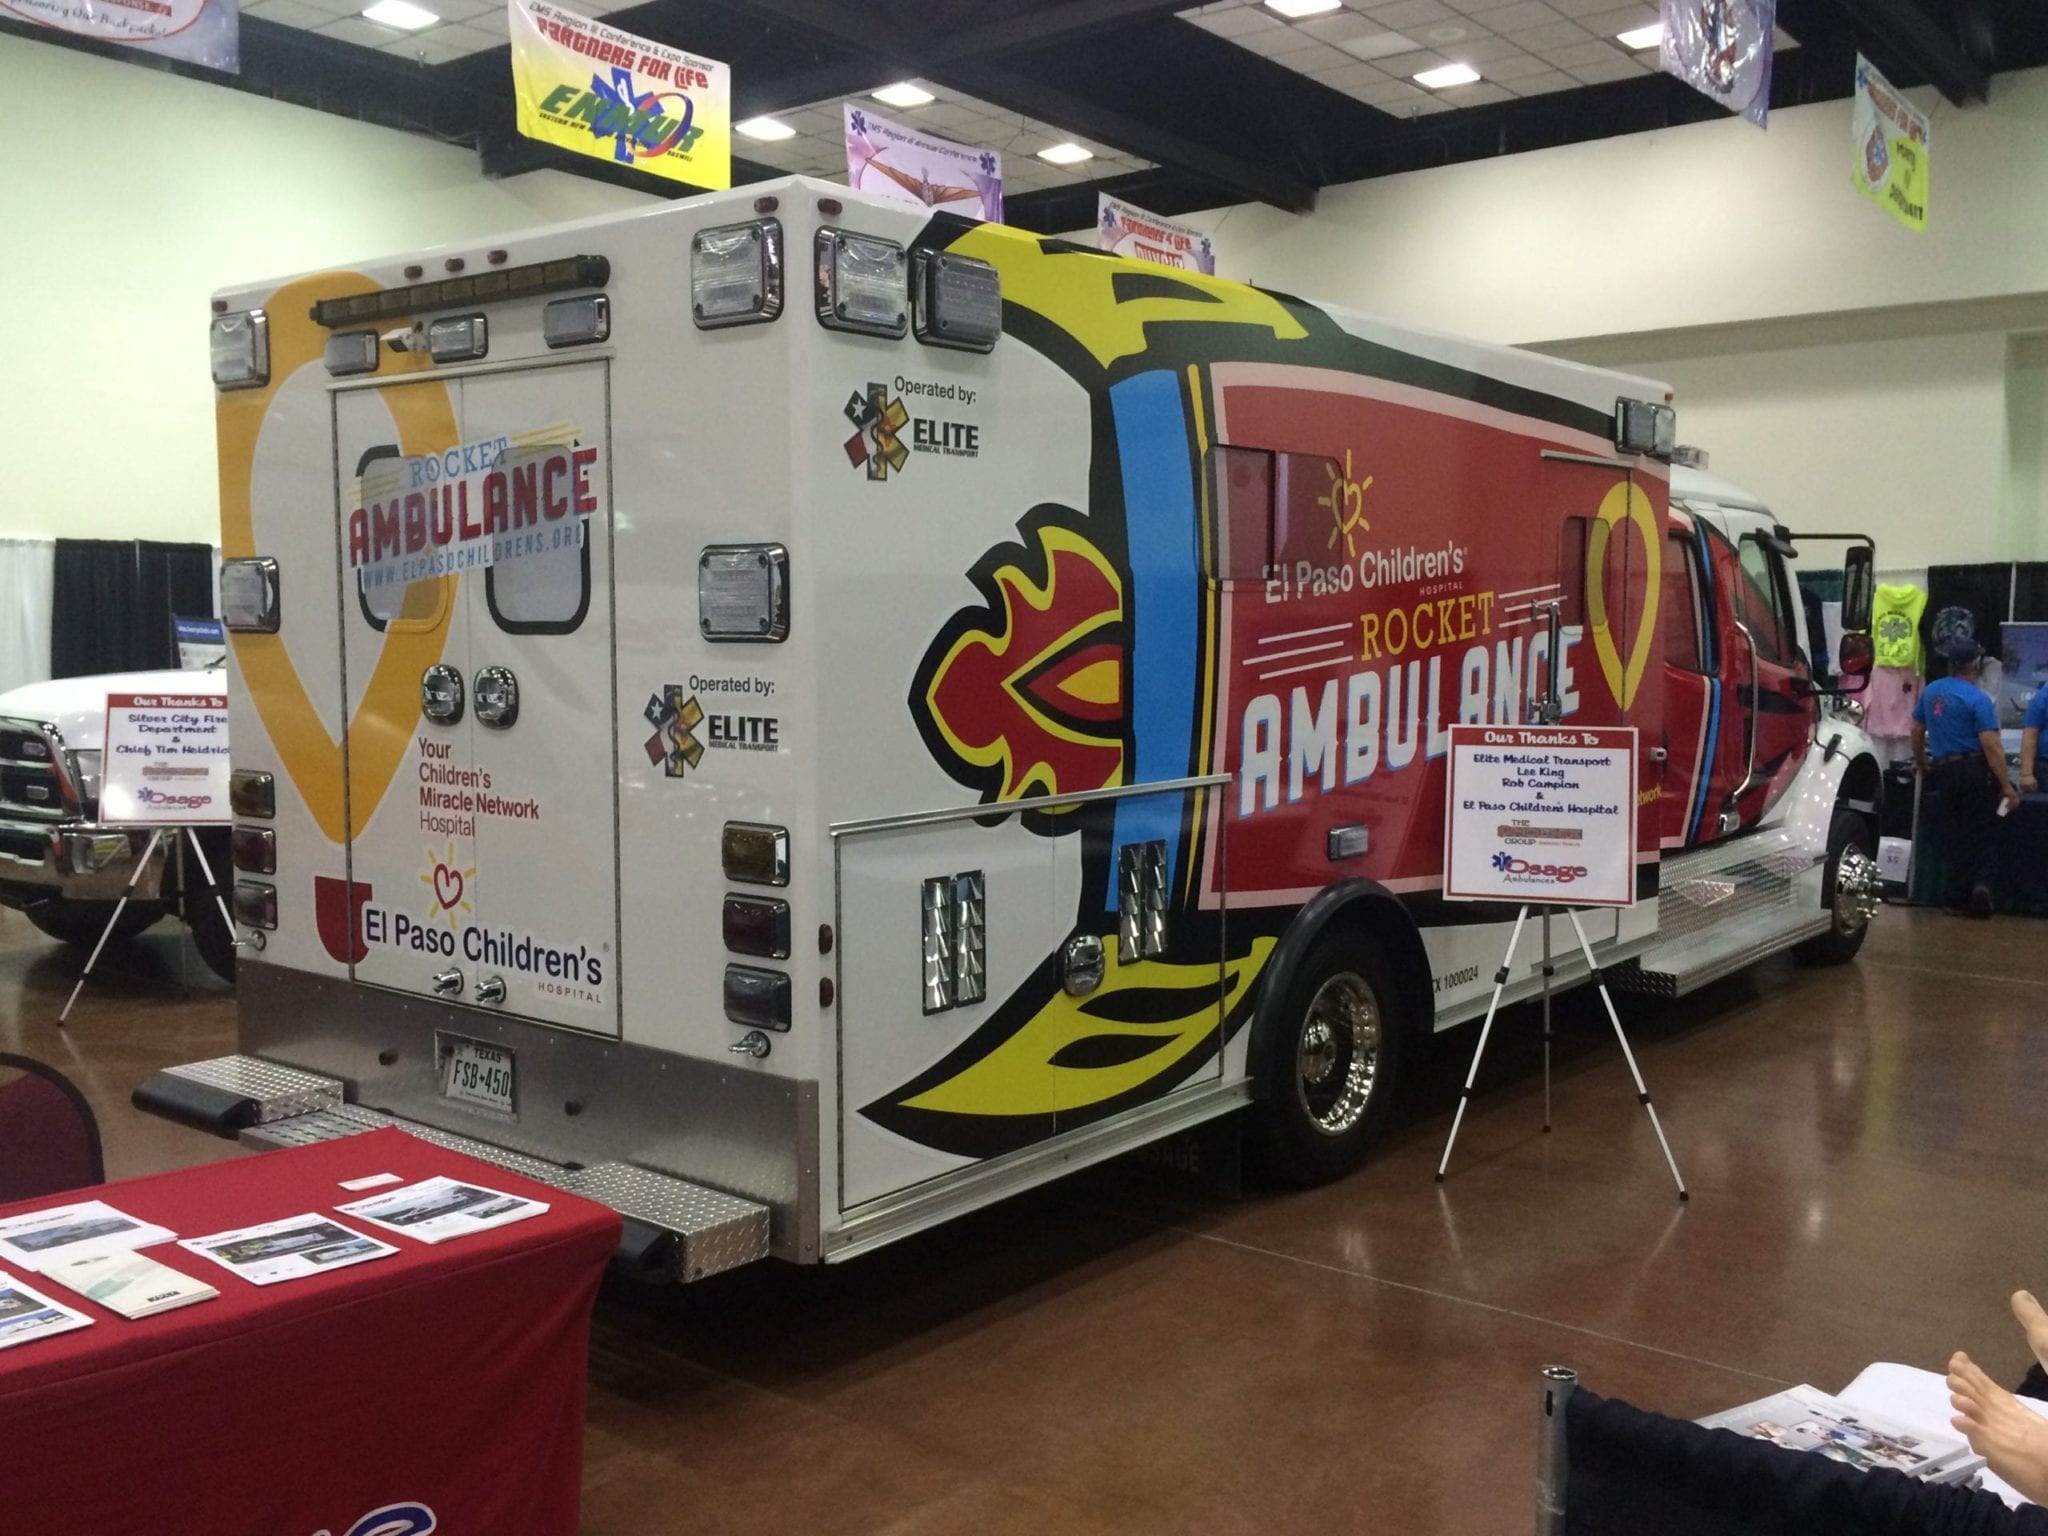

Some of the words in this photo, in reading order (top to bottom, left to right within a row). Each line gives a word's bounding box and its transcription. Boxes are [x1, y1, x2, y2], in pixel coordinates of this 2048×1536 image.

[529, 2, 552, 16] EMS
[553, 12, 588, 30] Region
[599, 28, 651, 52] Conference
[661, 49, 681, 63] Expo
[682, 56, 714, 72] Sponsor
[637, 55, 672, 82] FOR
[938, 145, 978, 163] Conference
[894, 375, 955, 400] Operated
[958, 386, 977, 405] by:
[913, 417, 979, 450] ELITE
[913, 444, 941, 455] MEDICAL
[409, 436, 509, 489] ROCKET
[349, 448, 597, 568] AMBULANCE
[1262, 563, 1289, 604] El
[1296, 561, 1354, 600] Paso
[1360, 540, 1464, 588] Children's
[1419, 581, 1464, 596] HOSPITAL
[1360, 591, 1495, 661] ROCKET
[689, 675, 751, 694] Operated
[755, 677, 775, 697] by:
[133, 697, 157, 706] Our
[160, 697, 207, 707] Thanks
[210, 697, 223, 707] To
[128, 714, 167, 723] Silver
[171, 714, 199, 725] City
[204, 714, 228, 723] Fire
[138, 724, 217, 735] Department
[708, 715, 779, 744] ELITE
[1238, 625, 1583, 820] AMBULANCE
[418, 737, 452, 760] Your
[1484, 731, 1514, 744] Our
[1518, 731, 1577, 745] Thanks
[1582, 731, 1600, 745] To
[116, 744, 152, 756] Chief
[156, 745, 178, 754] Tim
[1473, 754, 1500, 763] Elite
[1503, 754, 1550, 765] Medical
[1553, 756, 1612, 767] Transport
[419, 762, 492, 789] Children's
[1502, 778, 1525, 787] Rob
[1527, 778, 1580, 790] Campion
[1517, 767, 1536, 776] Lee
[1539, 768, 1565, 779] King
[419, 787, 473, 812] Miracle
[476, 793, 540, 820] Network
[1535, 792, 1544, 800] &
[1463, 801, 1475, 810] El
[1479, 802, 1506, 811] Paso
[1509, 801, 1565, 812] Children's
[1567, 804, 1619, 815] Hospital
[420, 811, 476, 838] Hospital
[1511, 819, 1530, 827] THE
[1504, 838, 1537, 846] GROUP
[1503, 873, 1555, 884] Ambulances
[1504, 859, 1588, 883] Osage
[366, 908, 387, 944] El
[395, 914, 455, 957] Paso
[463, 926, 603, 986] Children's
[1444, 965, 1479, 990] 1000024
[537, 981, 603, 1004] HOSPITAL
[474, 1047, 501, 1063] TEXAS
